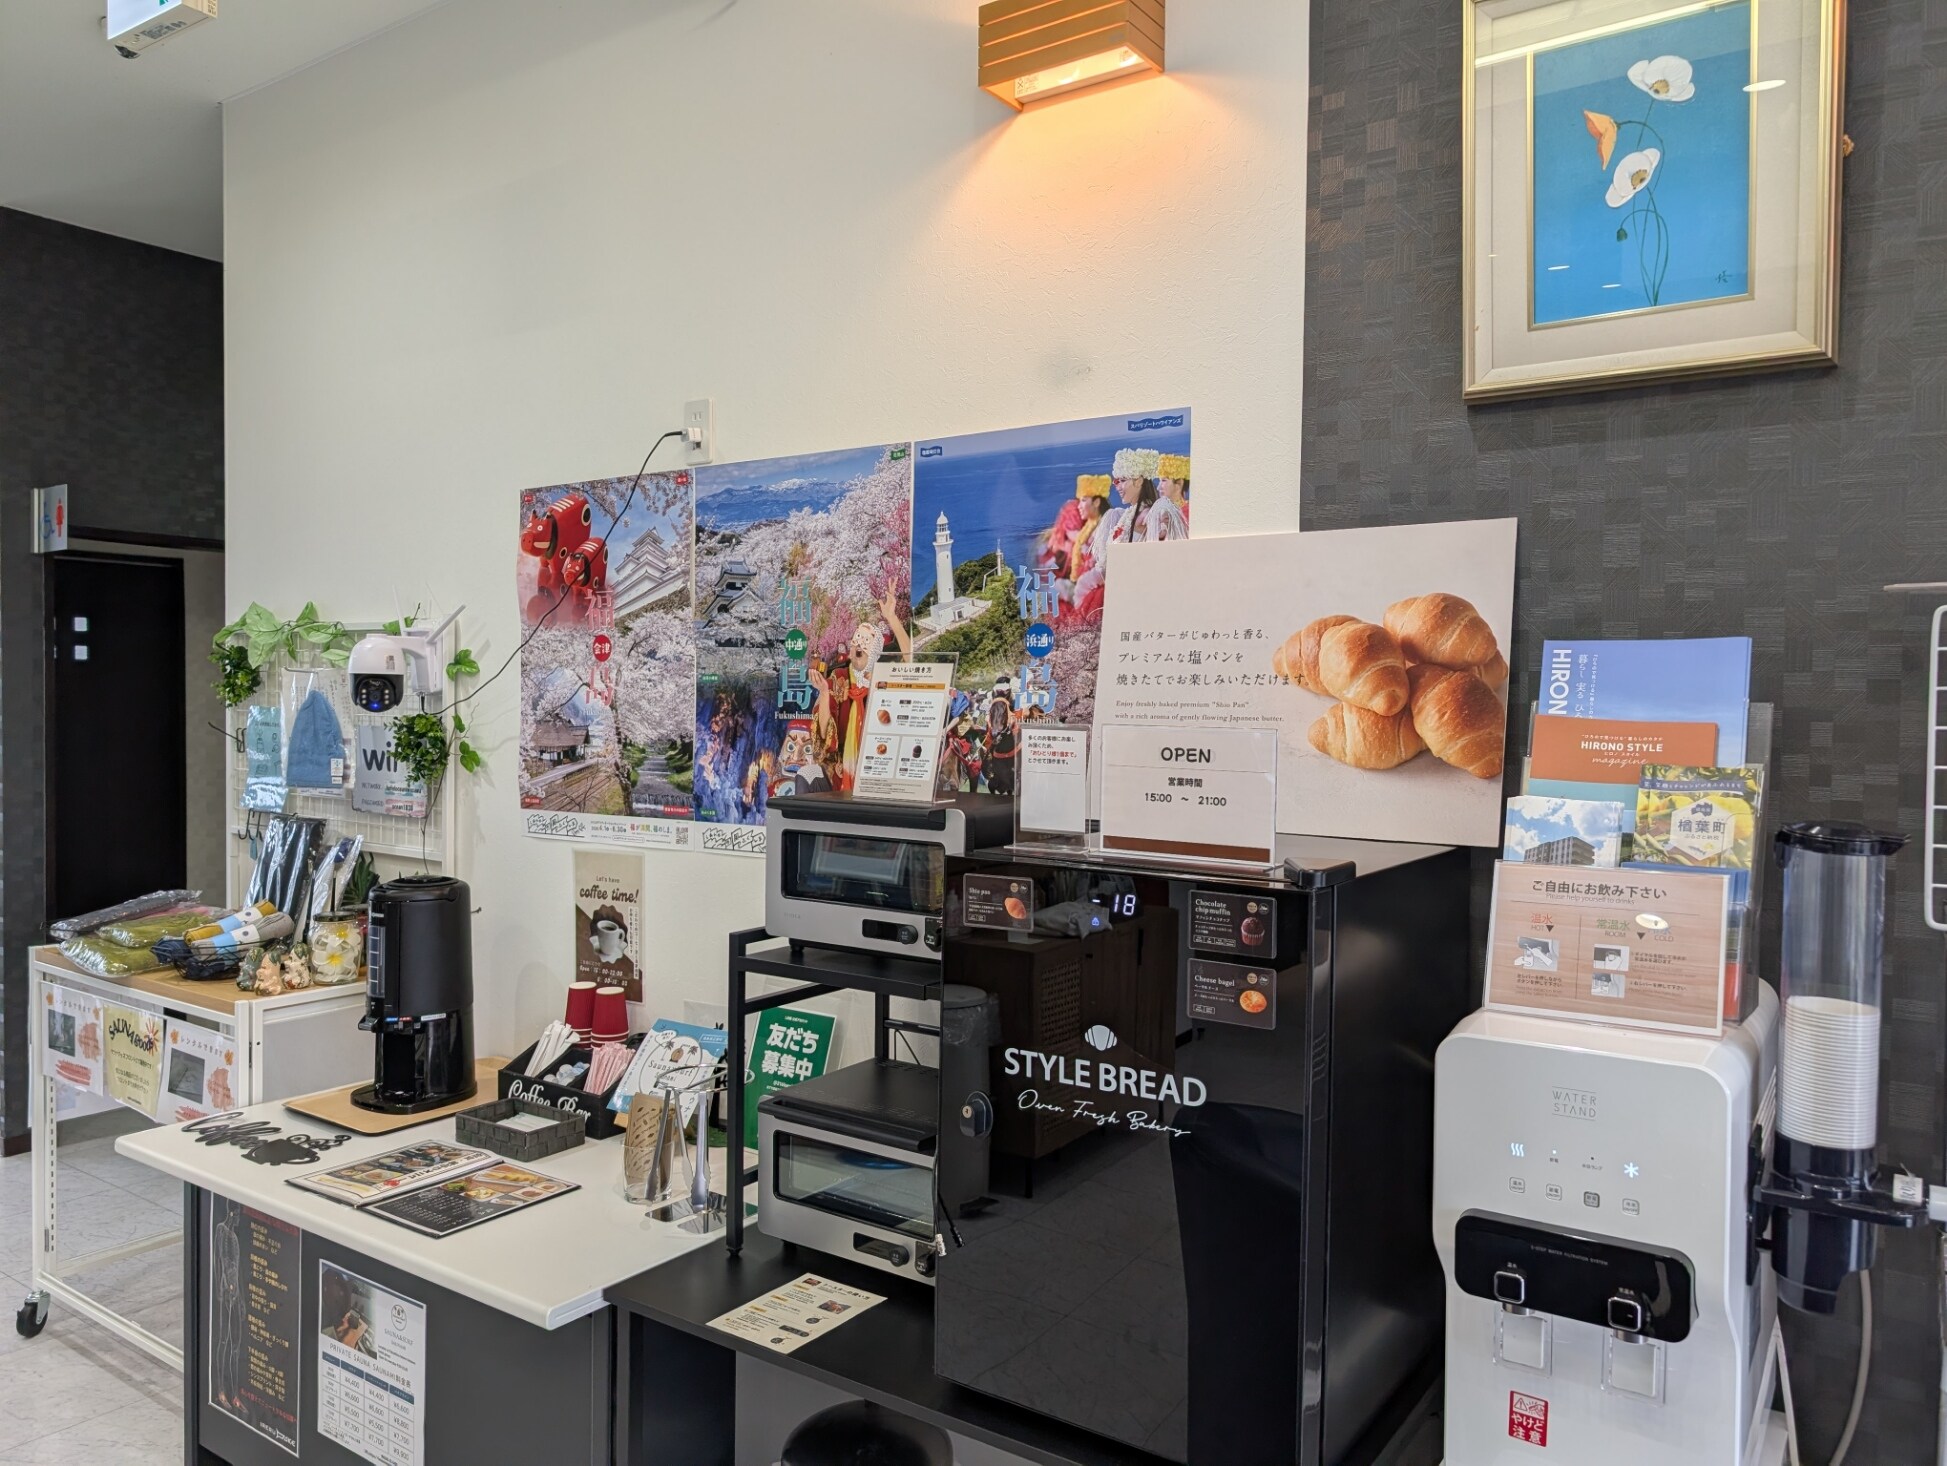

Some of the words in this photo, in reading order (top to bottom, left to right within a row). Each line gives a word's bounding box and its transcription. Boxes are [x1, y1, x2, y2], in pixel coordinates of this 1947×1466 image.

[1016, 564, 1060, 620] 福
[777, 575, 812, 626] 福
[1026, 634, 1054, 648] 浜通り
[1120, 628, 1270, 642] 国産バターがじゅわっと香る、
[594, 642, 610, 654] 会津
[1118, 650, 1244, 664] プレミアムな塩パンを
[892, 666, 932, 674] おいしい焼き方
[1116, 700, 1133, 709] Enjoy
[1136, 700, 1157, 709] freshly
[1115, 712, 1129, 720] with
[1180, 714, 1200, 722] gently
[1202, 714, 1228, 723] flowing
[1229, 715, 1260, 723] Japanese
[1581, 741, 1624, 751] HIRONO
[1627, 743, 1663, 752] STYLE
[1161, 747, 1211, 763] OPEN
[1592, 758, 1648, 768] magazine
[1168, 777, 1203, 788] 営業時間
[1145, 793, 1172, 803] 15:00
[1198, 796, 1227, 806] 21:00
[1678, 819, 1725, 833] 楢葉町
[580, 884, 608, 900] coffee
[612, 888, 639, 903] time!
[1532, 880, 1667, 899] ご自由にお飲み下さい
[1195, 899, 1227, 909] Chocolate
[1546, 893, 1565, 901] Please
[1581, 896, 1606, 904] yourself
[1195, 906, 1209, 915] chip
[1209, 908, 1231, 916] muffin
[1531, 913, 1553, 924] 温水
[1597, 919, 1630, 931] 常温水
[1605, 930, 1627, 938] ROOM
[1194, 975, 1217, 984] Cheese
[1218, 978, 1235, 987] bagel
[766, 1023, 819, 1054] 友だち
[762, 1050, 813, 1081] 募集中
[1004, 1047, 1091, 1088] STYLE
[1099, 1063, 1207, 1107] BREAD
[1552, 1090, 1597, 1106] WATER
[1017, 1089, 1065, 1109] Oven
[1073, 1100, 1120, 1126] Fresh
[1126, 1110, 1191, 1137] Bakery
[1553, 1103, 1597, 1118] STAND
[330, 1342, 351, 1358] PRIVATE
[354, 1354, 370, 1368] SAUNA
[1511, 1413, 1545, 1432] やけど
[1512, 1424, 1541, 1444] 注意
